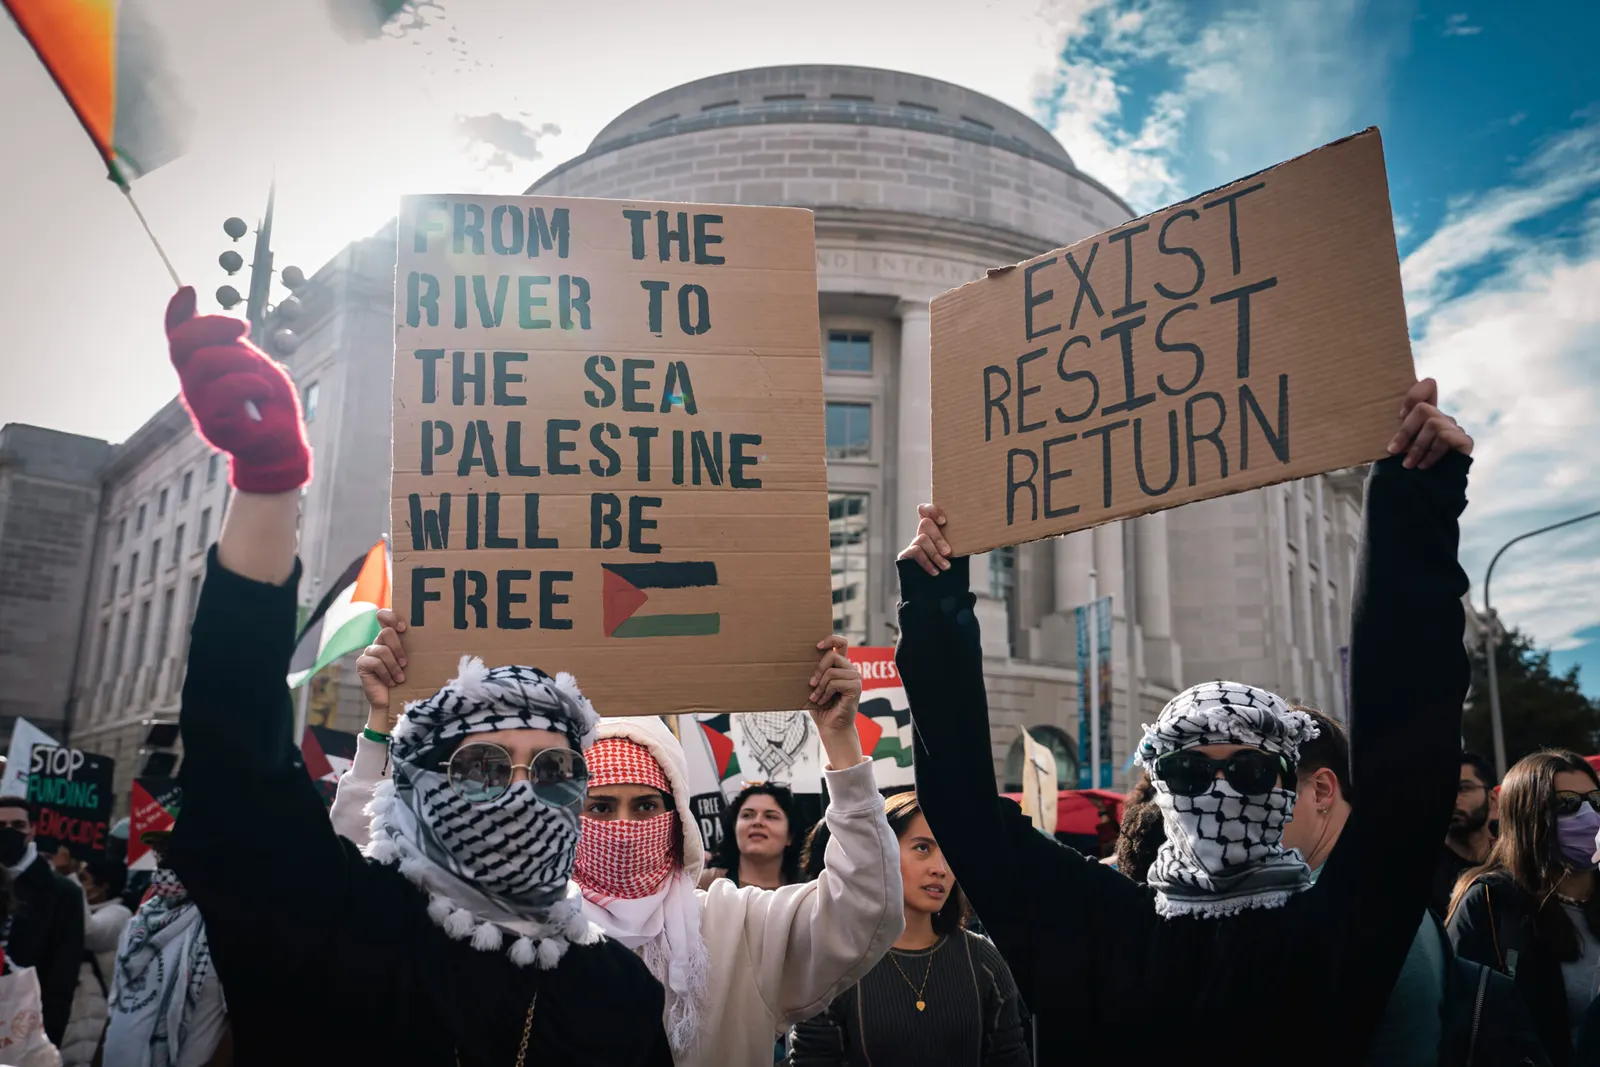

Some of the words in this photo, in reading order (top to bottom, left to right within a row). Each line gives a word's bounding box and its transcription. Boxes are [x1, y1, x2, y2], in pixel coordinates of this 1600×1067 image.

[413, 202, 570, 259] FROM
[622, 210, 726, 265] THE
[1024, 182, 1266, 343] EXIST
[406, 271, 592, 330] RIVER
[640, 280, 711, 336] TO
[414, 349, 529, 406] THE
[584, 354, 698, 415] SEA
[983, 276, 1278, 442] RESIST
[421, 419, 762, 489] PALESTINE
[1006, 374, 1290, 526] RETURN
[408, 492, 559, 551] WILL
[590, 492, 663, 554] BE
[410, 567, 574, 630] FREE
[27, 774, 99, 809] FUNDING
[30, 745, 85, 782] STOP
[36, 807, 108, 851] ENOCIDE
[698, 797, 720, 816] FREE
